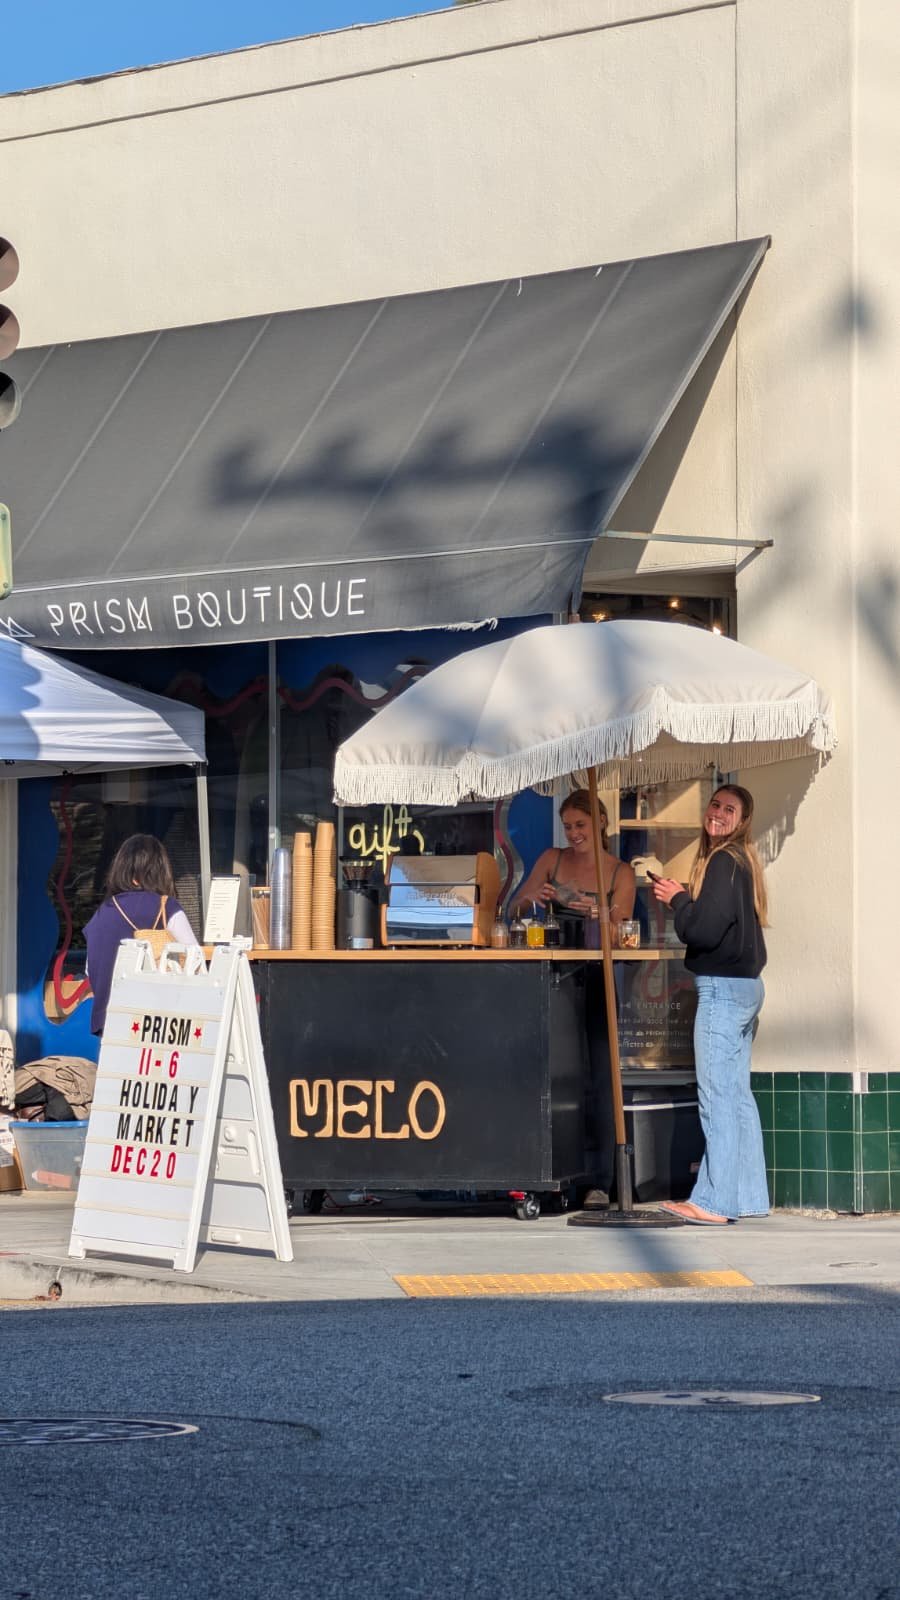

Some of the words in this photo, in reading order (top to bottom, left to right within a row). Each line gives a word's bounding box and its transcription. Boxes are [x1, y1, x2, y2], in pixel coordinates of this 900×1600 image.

[47, 597, 153, 636] PRISM
[173, 578, 367, 631] BOUTIQUE
[141, 1015, 191, 1046] PRISM
[120, 1079, 199, 1113] HOLIDAY
[289, 1079, 446, 1140] MELO
[117, 1113, 194, 1147] MARKET
